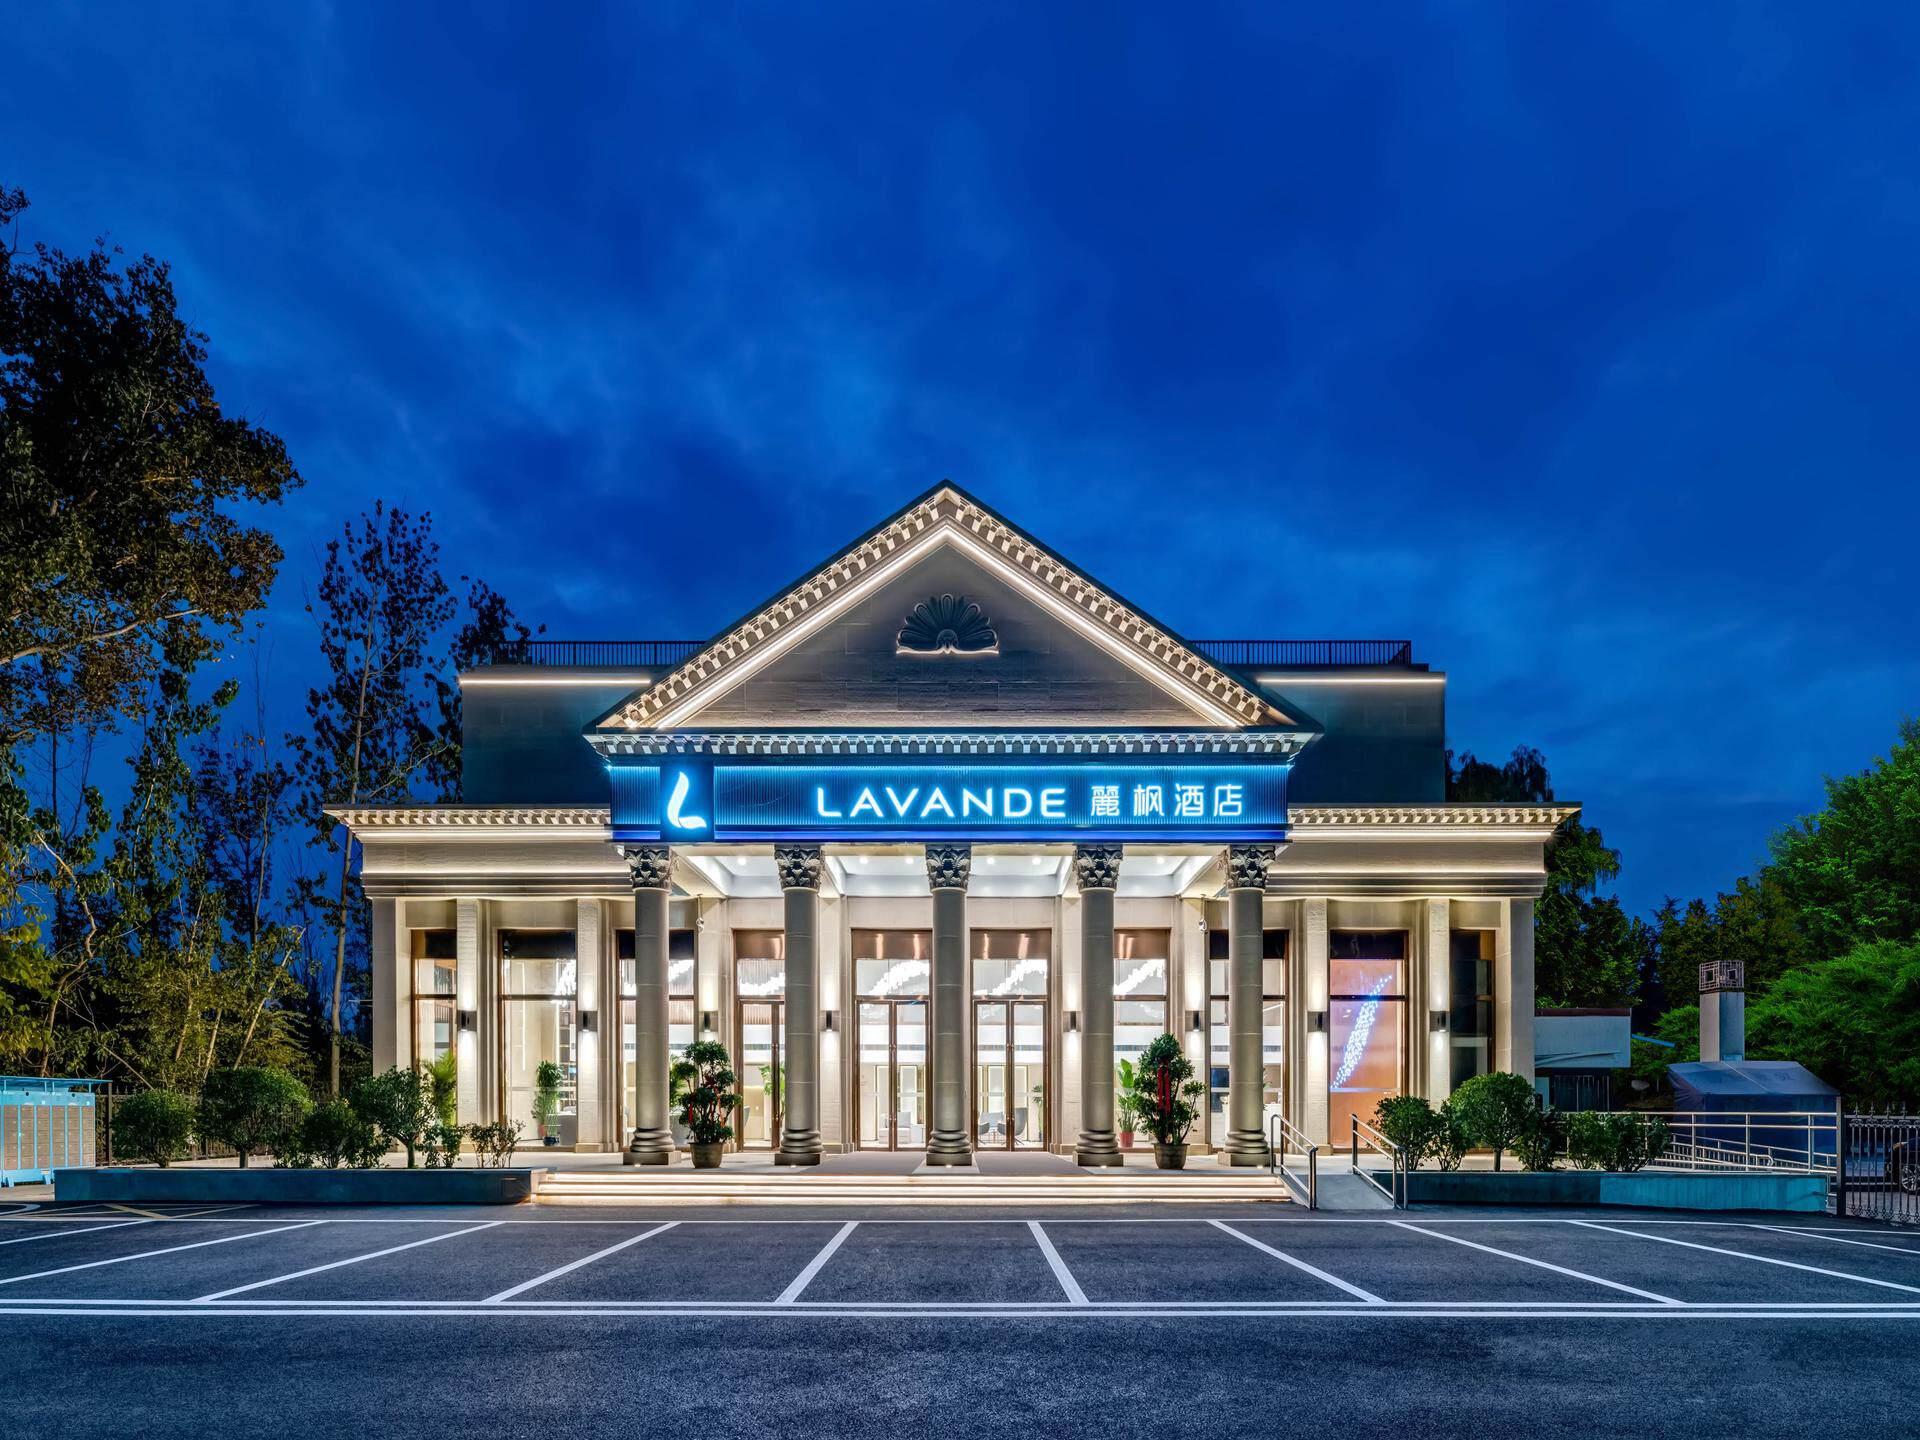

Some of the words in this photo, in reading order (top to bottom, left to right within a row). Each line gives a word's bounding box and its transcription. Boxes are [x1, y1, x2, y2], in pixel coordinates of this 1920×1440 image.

[817, 787, 1067, 817] LAVANDE
[1090, 783, 1243, 817] 麗枫酒店
